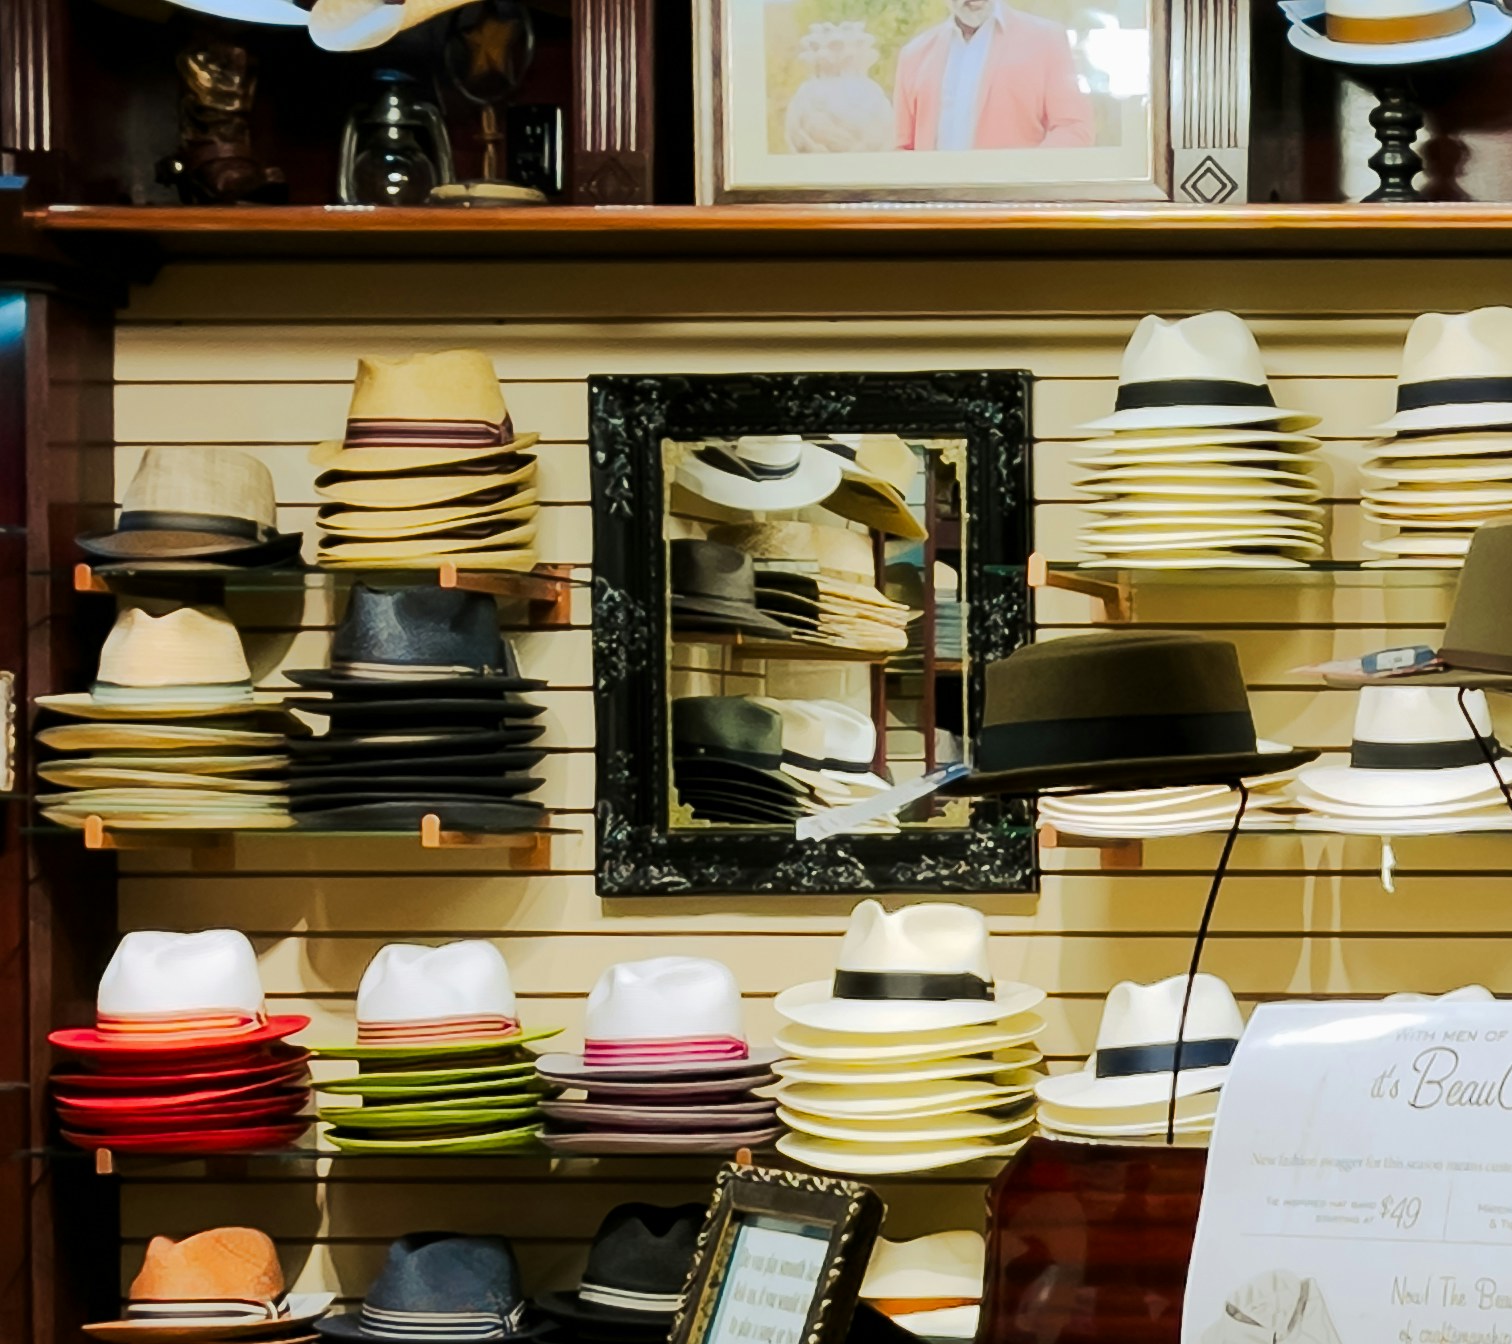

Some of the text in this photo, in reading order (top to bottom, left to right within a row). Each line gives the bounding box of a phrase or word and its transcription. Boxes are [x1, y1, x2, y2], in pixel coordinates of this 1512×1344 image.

[1396, 1029, 1436, 1042] WITH
[1442, 1030, 1478, 1042] MEN
[1484, 1030, 1509, 1042] OF
[1378, 1194, 1423, 1230] $49
[1439, 1275, 1467, 1307] The
